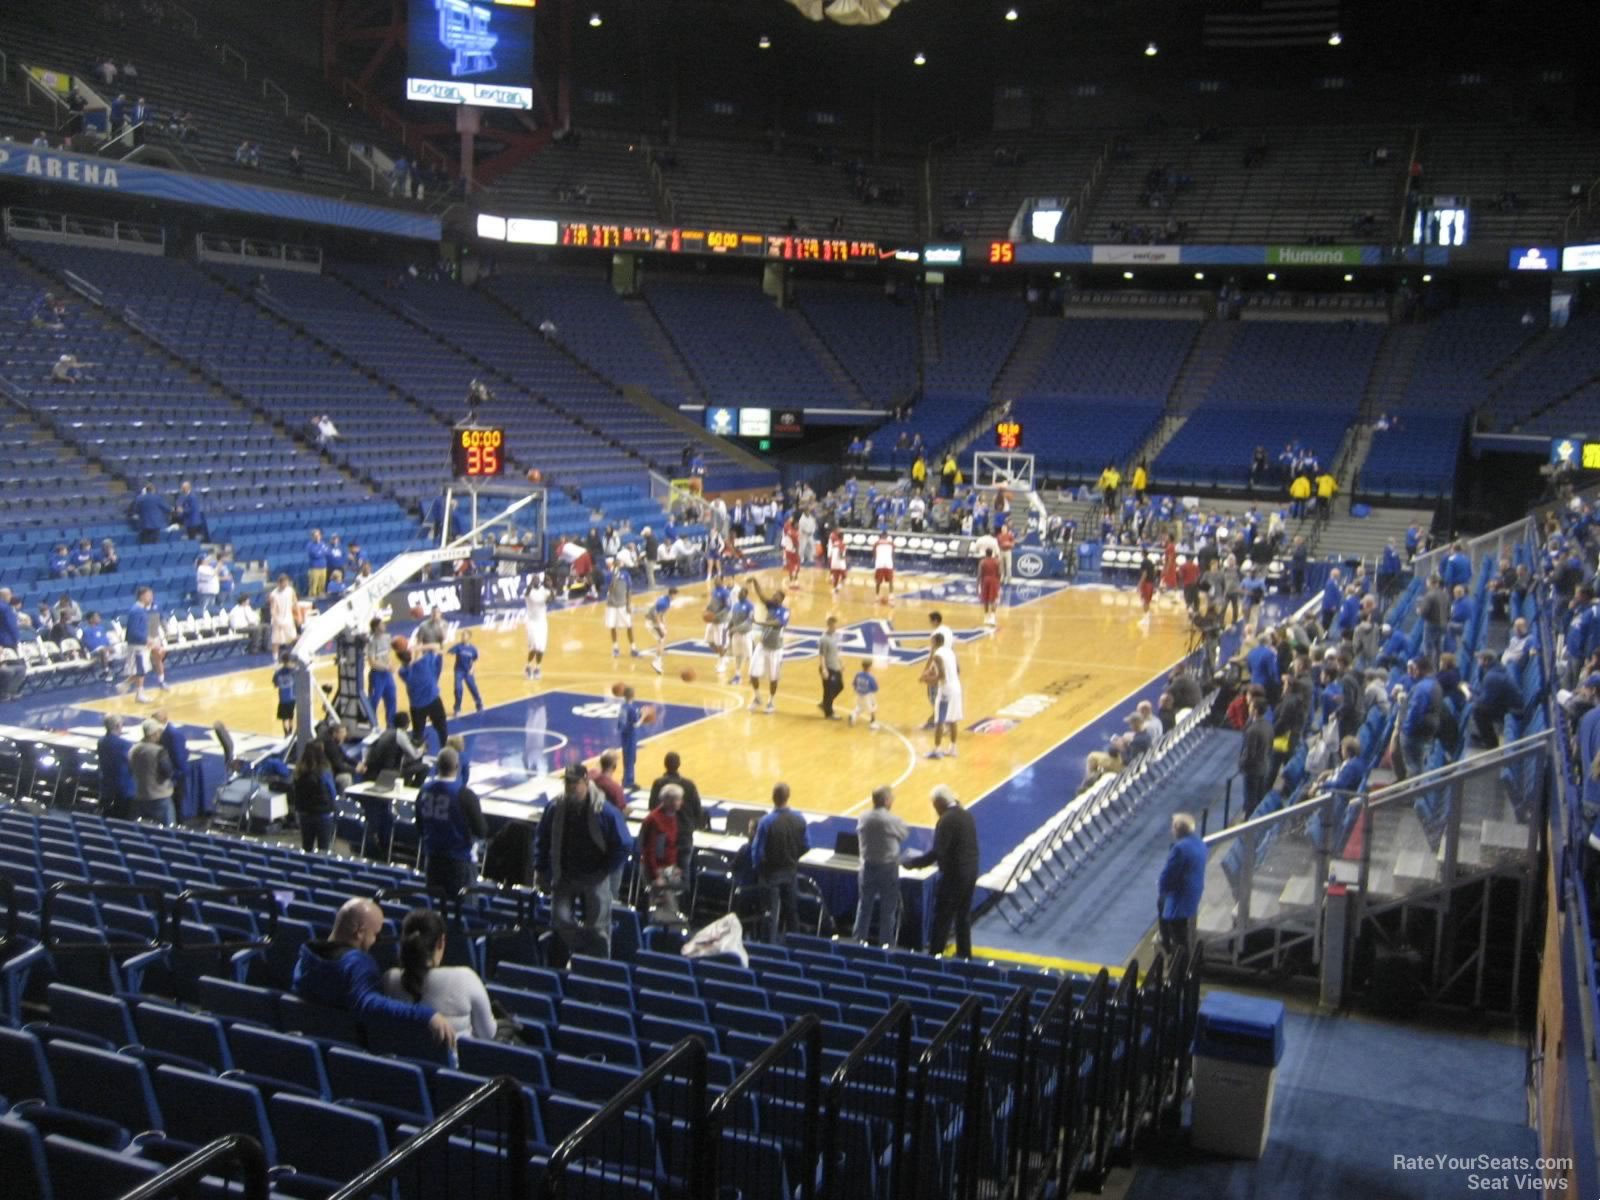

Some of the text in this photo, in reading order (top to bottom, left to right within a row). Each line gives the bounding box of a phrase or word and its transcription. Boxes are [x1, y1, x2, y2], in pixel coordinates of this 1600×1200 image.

[26, 155, 119, 187] ARENA
[990, 242, 1012, 263] 35
[1279, 248, 1344, 264] Humana
[462, 430, 501, 447] 60:00
[467, 447, 497, 474] 35
